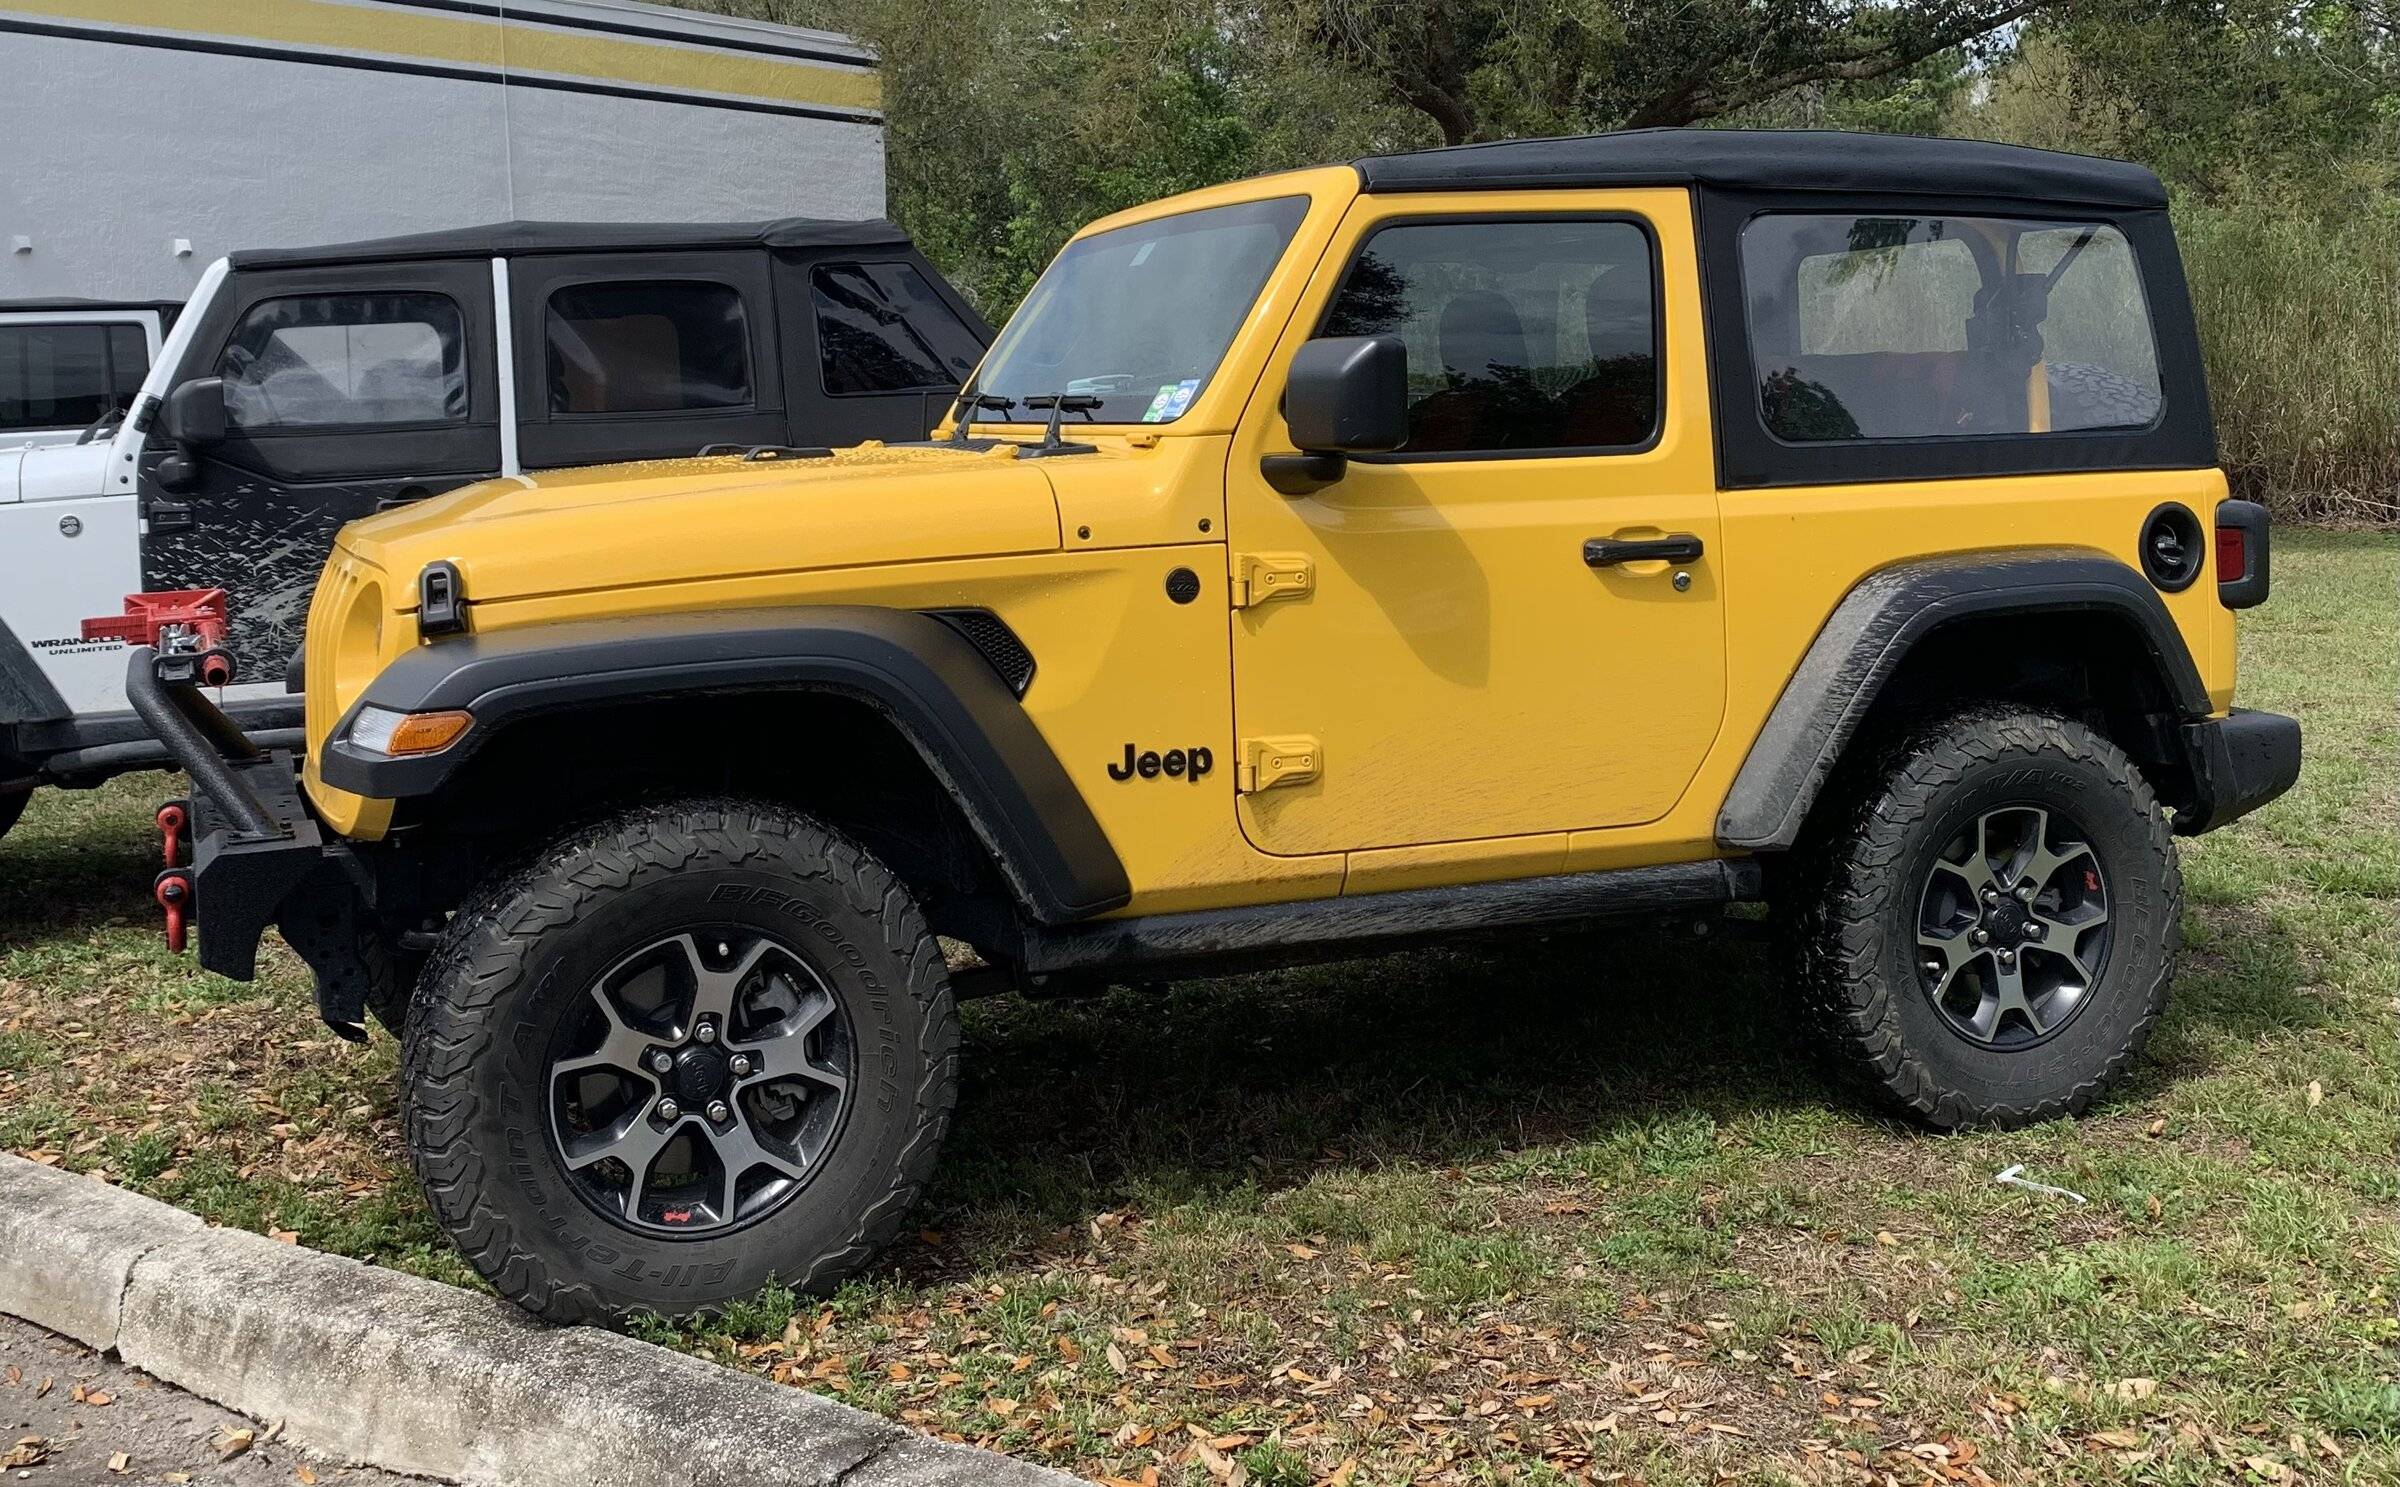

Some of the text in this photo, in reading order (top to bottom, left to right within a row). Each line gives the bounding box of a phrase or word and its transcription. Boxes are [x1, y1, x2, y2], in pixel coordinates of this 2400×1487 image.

[31, 635, 127, 649] WRANGLE
[49, 645, 123, 656] UNLIMITED
[1107, 743, 1214, 783] Jeep
[705, 882, 903, 1114] BFGoodrich
